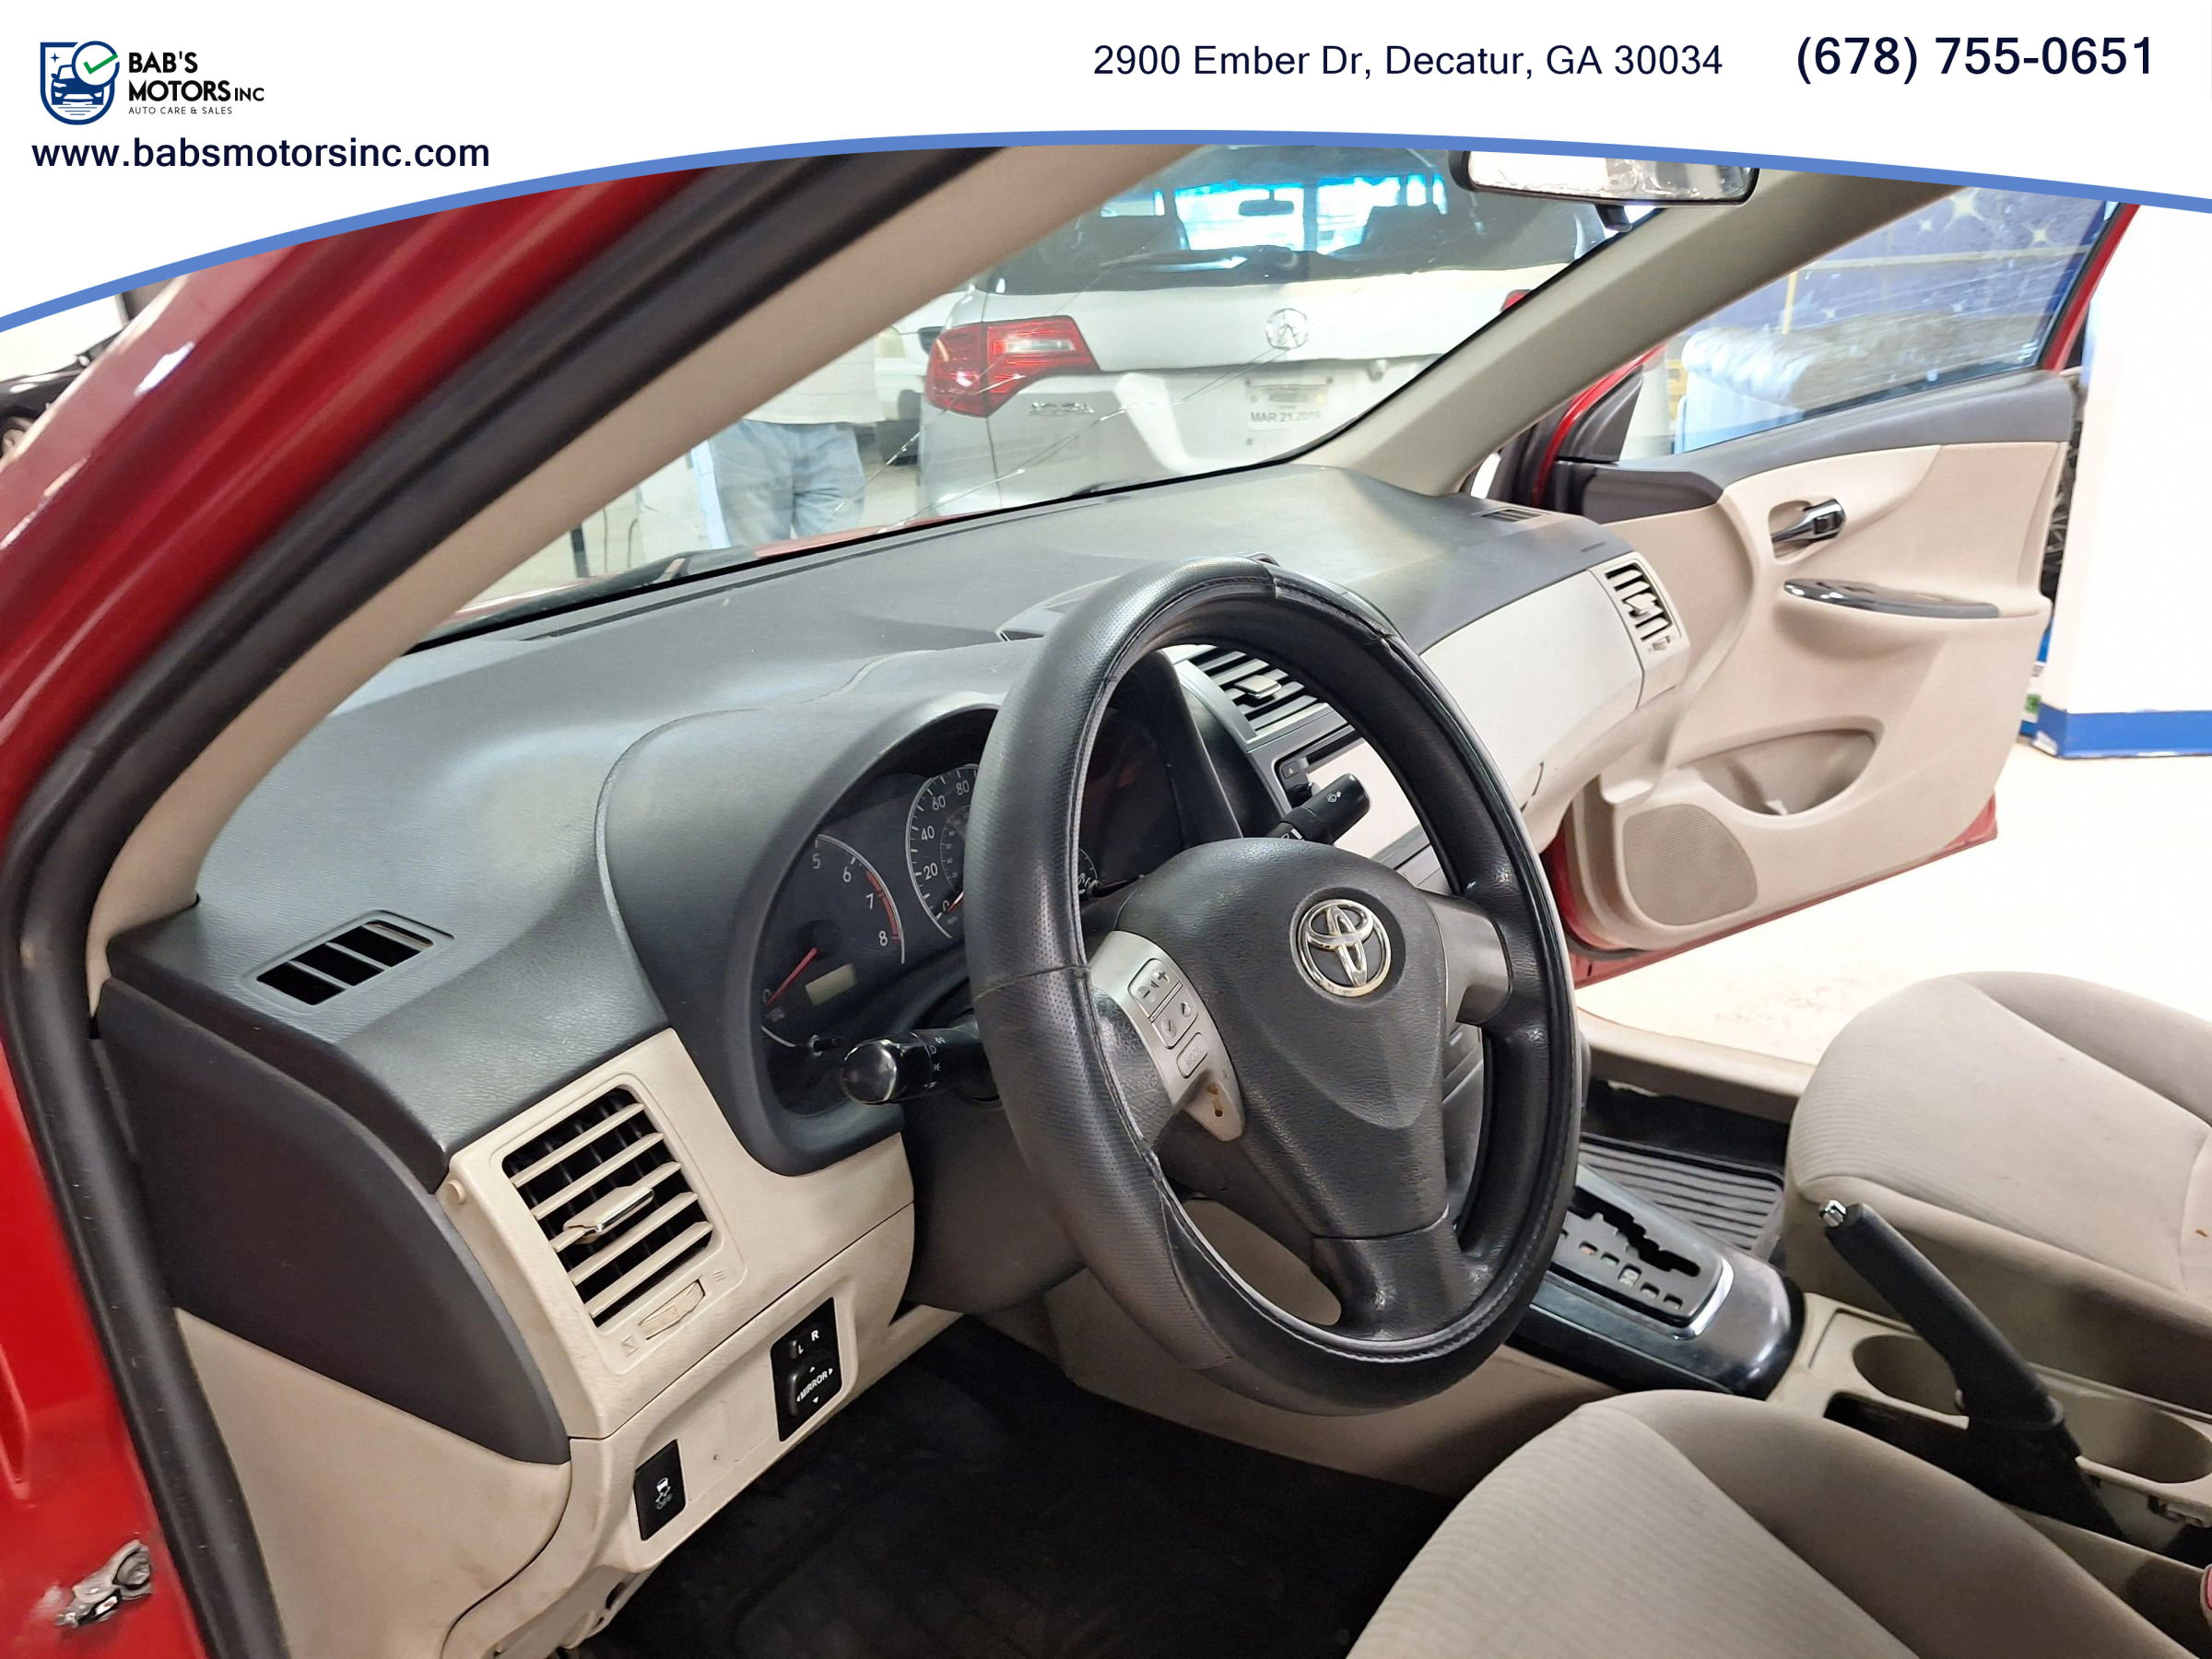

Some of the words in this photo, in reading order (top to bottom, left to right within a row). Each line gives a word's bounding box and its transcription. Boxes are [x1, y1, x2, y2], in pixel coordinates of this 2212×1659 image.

[1250, 412, 1277, 422] MAR
[955, 780, 970, 795] 80
[932, 794, 947, 811] 60
[921, 825, 935, 841] 40
[812, 853, 821, 869] 5
[842, 866, 853, 883] 6
[923, 863, 938, 880] 20
[865, 892, 875, 910] 7
[878, 930, 888, 947] 8
[811, 1330, 819, 1341] R
[798, 1345, 804, 1355] L
[800, 1371, 828, 1400] MIRROR
